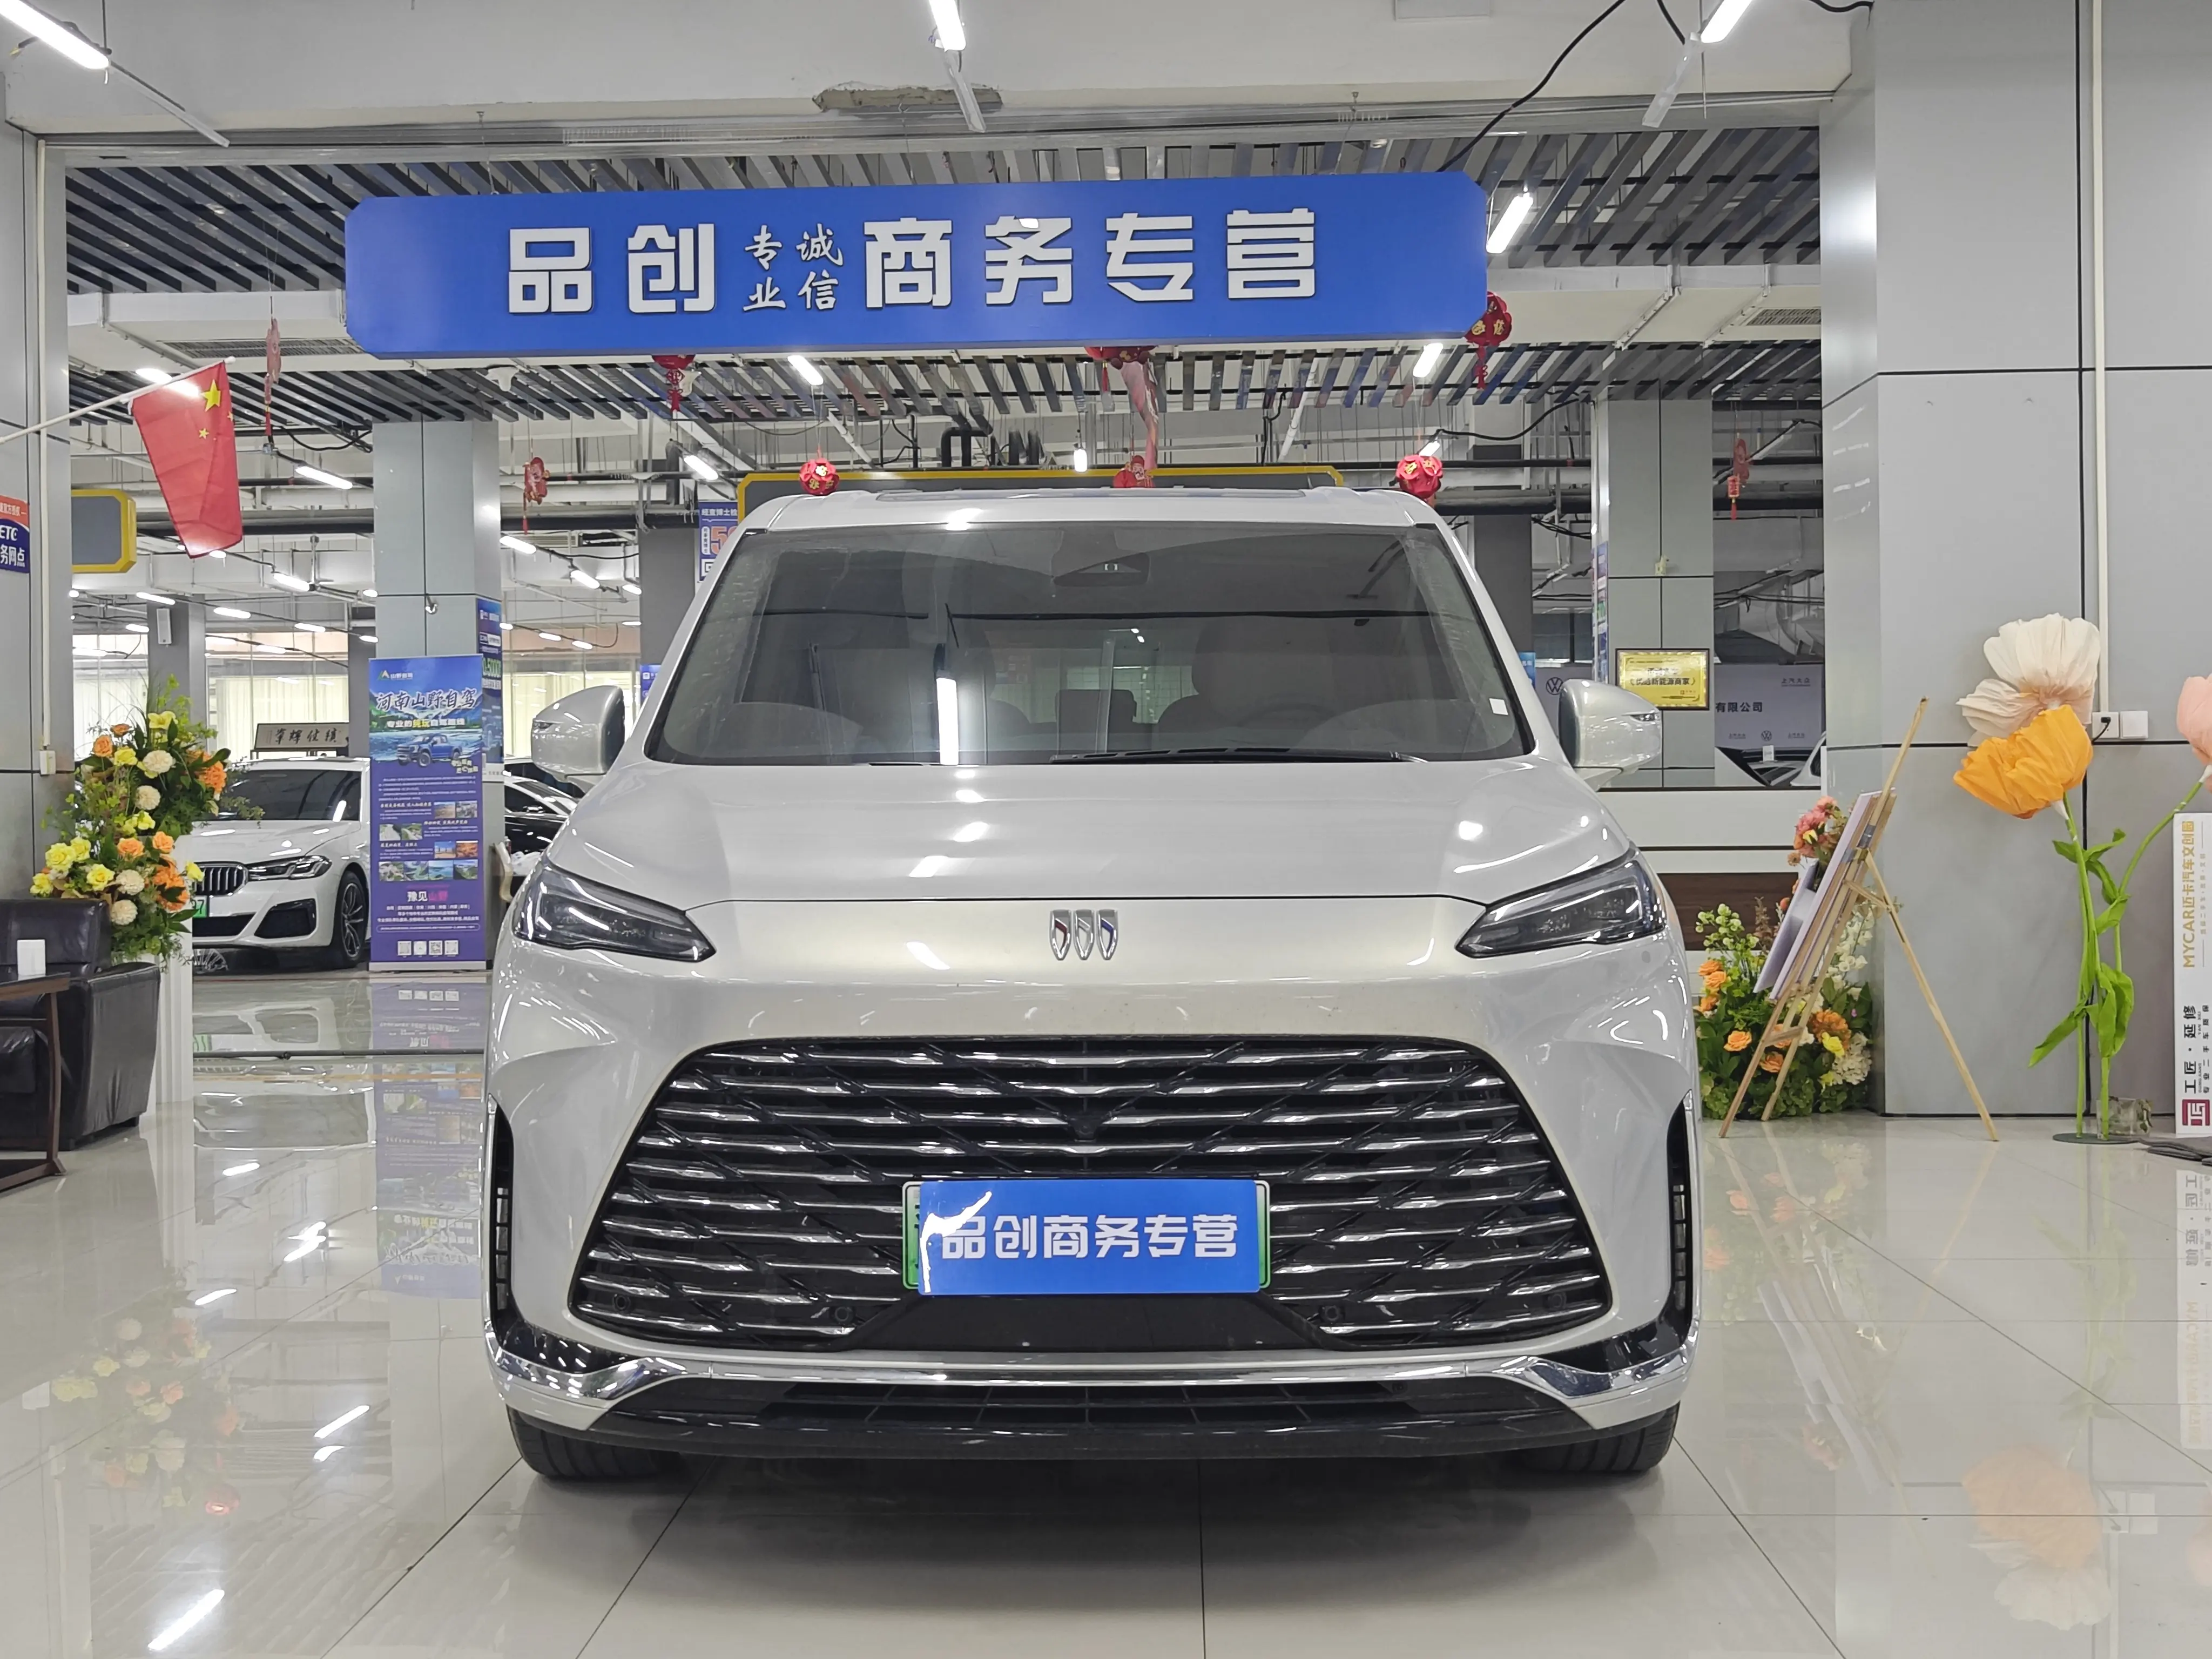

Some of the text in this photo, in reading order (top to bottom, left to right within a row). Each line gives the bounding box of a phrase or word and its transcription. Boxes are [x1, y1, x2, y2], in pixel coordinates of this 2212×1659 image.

[507, 207, 1316, 315] 品创 商务专营
[375, 687, 477, 711] 河南山野自驾
[1715, 702, 1763, 712] 有限公司
[942, 1215, 1238, 1258] 品创商务专营
